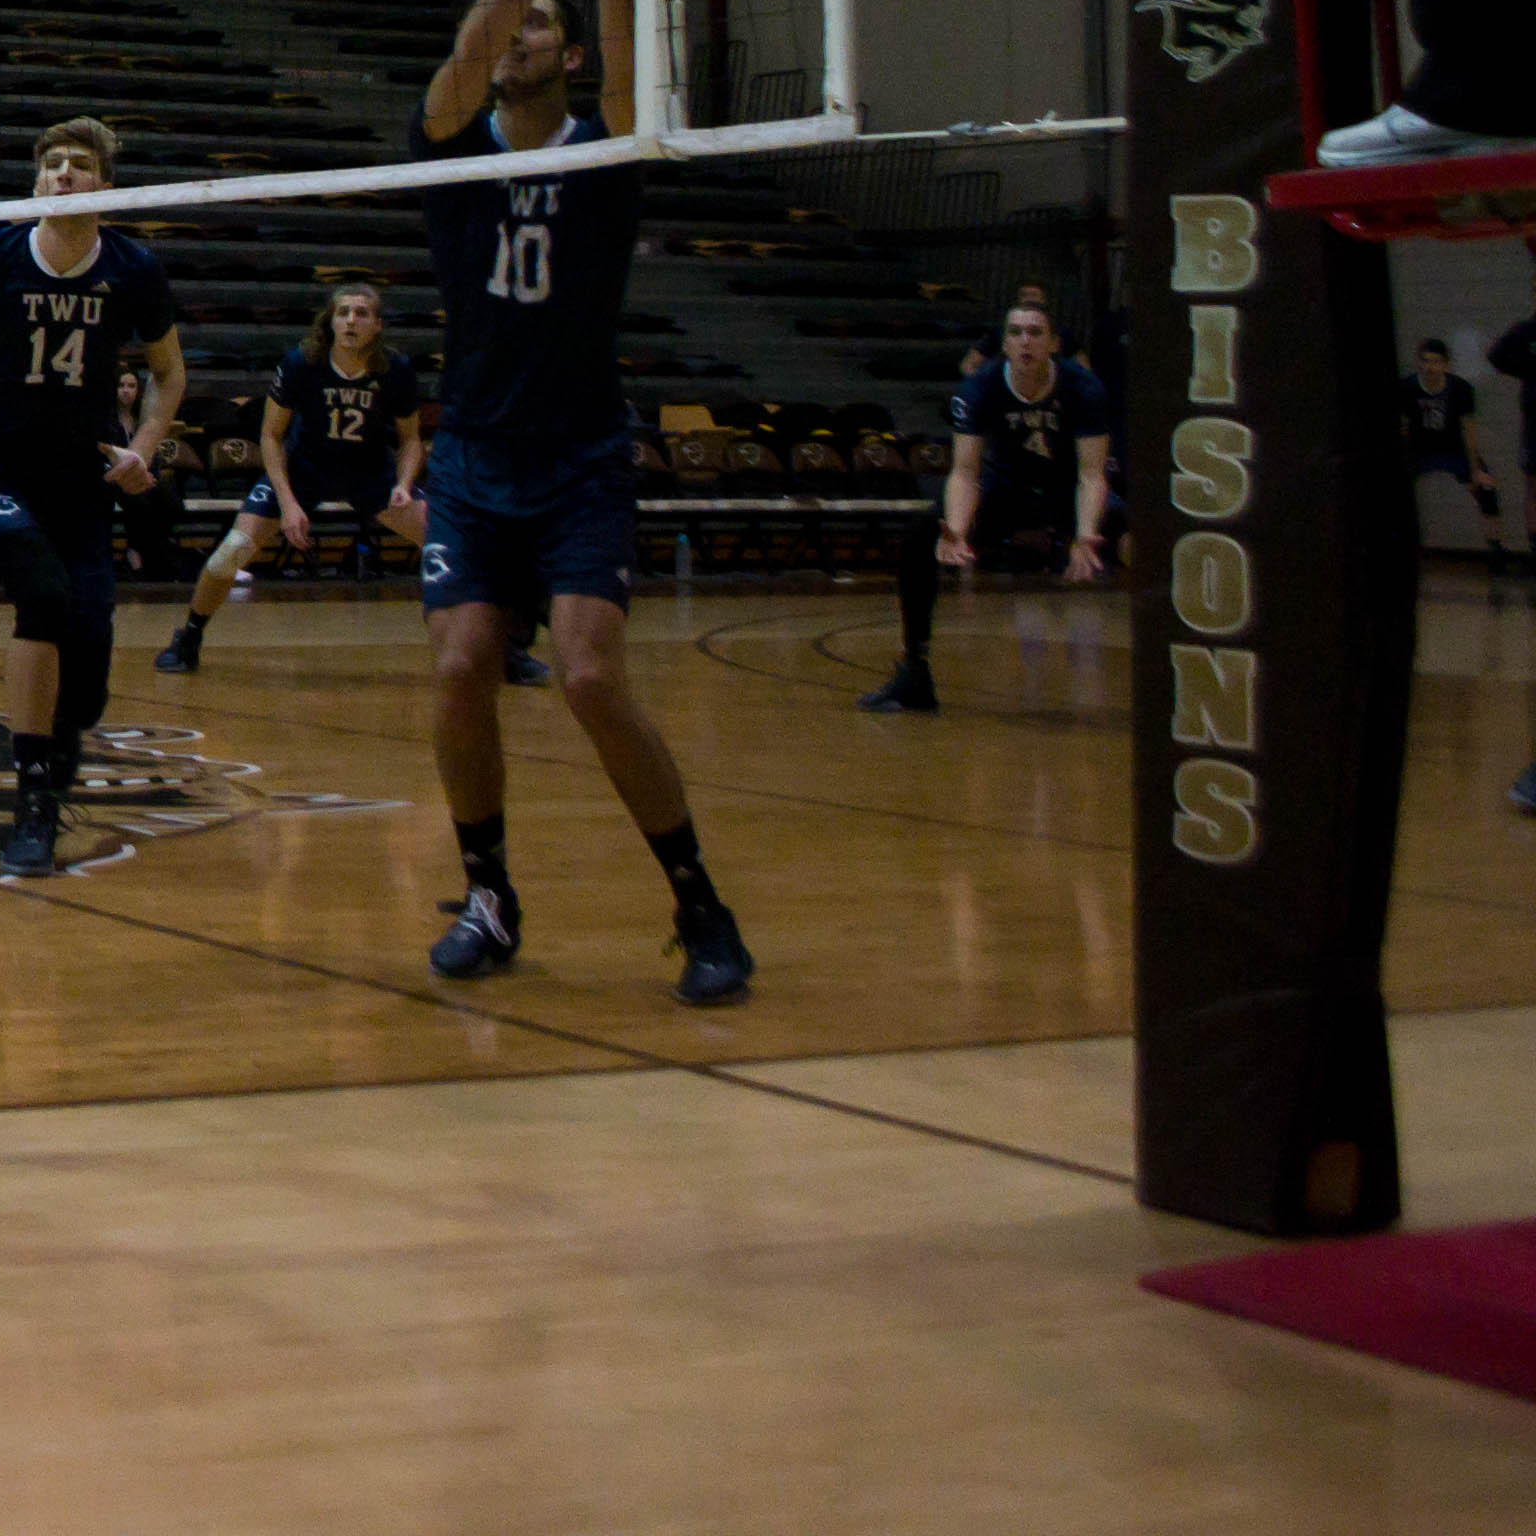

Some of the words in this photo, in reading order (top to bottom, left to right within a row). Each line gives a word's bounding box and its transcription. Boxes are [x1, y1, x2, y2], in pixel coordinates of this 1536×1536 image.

[485, 219, 552, 304] 10
[21, 292, 105, 326] TWU
[24, 326, 87, 389] 14
[321, 387, 374, 410] TWU
[326, 407, 366, 442] 12
[1169, 193, 1260, 865] BISONS
